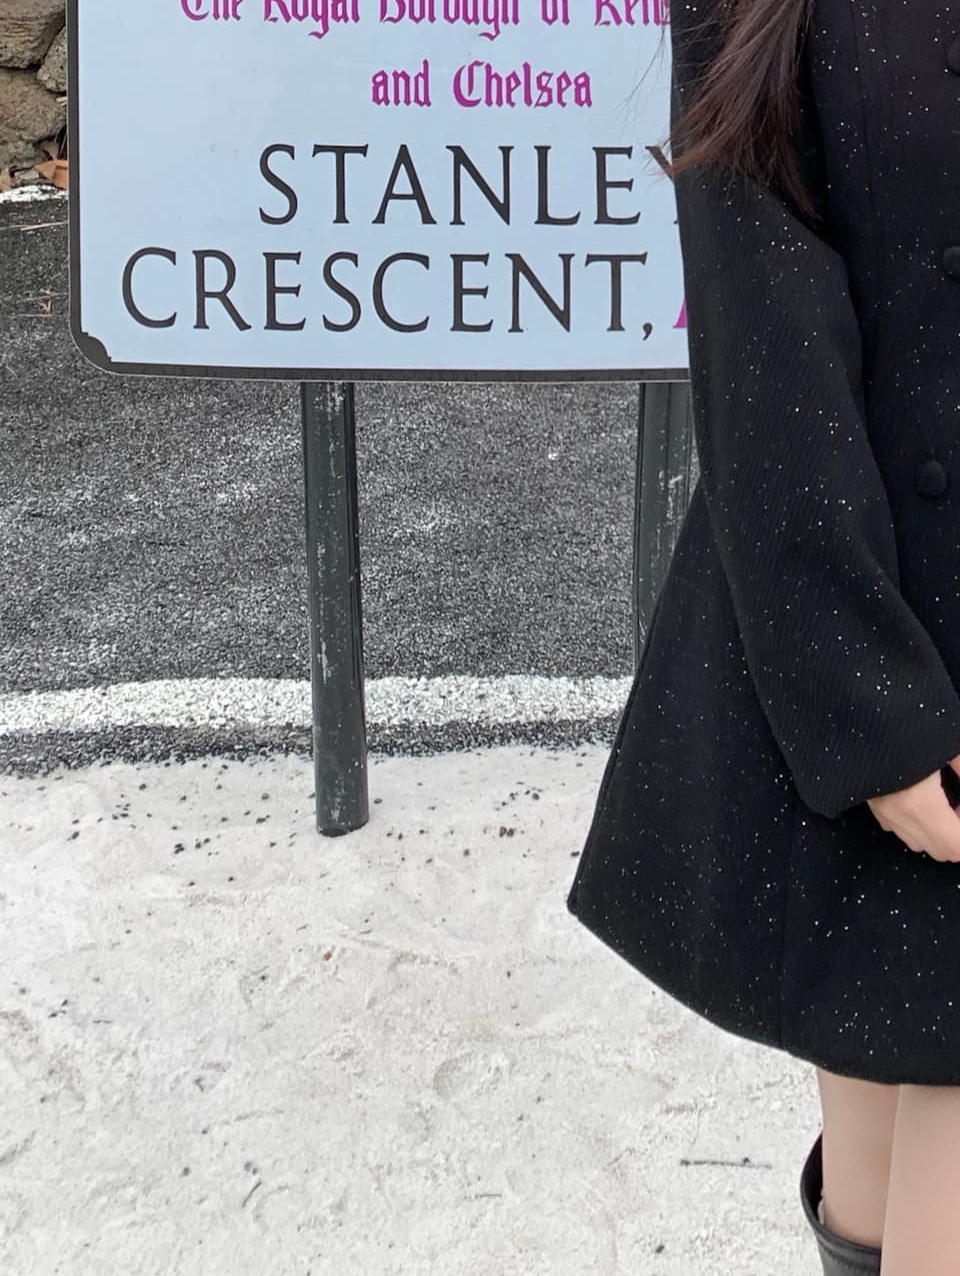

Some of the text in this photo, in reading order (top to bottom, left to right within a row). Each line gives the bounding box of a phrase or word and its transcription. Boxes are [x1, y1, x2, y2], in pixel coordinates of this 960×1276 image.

[371, 59, 594, 108] and Chelsea
[121, 245, 654, 342] CRESCENT,
